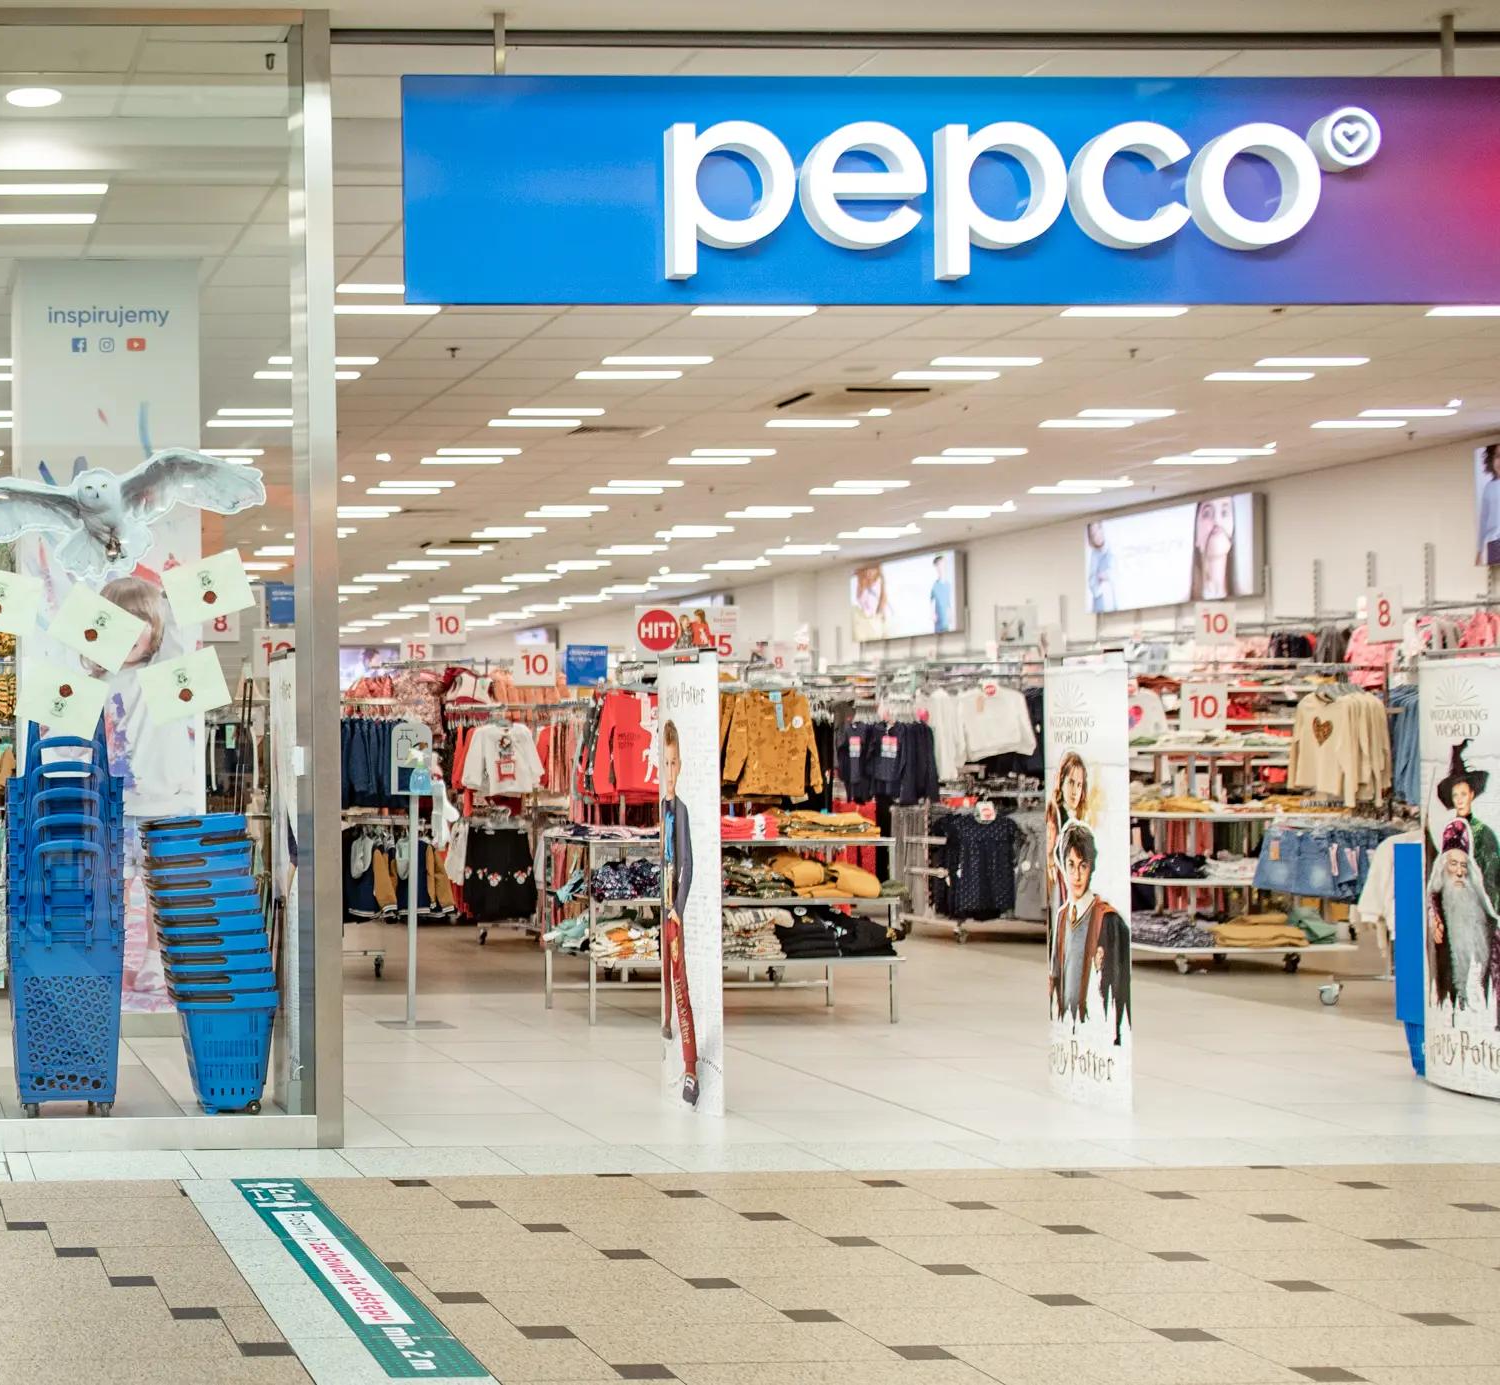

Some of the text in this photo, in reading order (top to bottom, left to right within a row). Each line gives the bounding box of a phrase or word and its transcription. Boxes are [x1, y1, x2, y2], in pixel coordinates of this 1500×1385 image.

[664, 120, 1322, 281] pepco
[48, 306, 170, 328] inspirujemy
[1203, 613, 1229, 634] 10
[1378, 599, 1391, 627] 8
[436, 616, 460, 634] 10
[640, 621, 676, 639] HIT!
[407, 644, 426, 660] 15
[707, 634, 733, 657] 15
[521, 654, 548, 675] 10
[1189, 695, 1219, 718] 10
[1430, 708, 1488, 722] WIZARDING
[1054, 730, 1089, 745] WORLD
[1436, 722, 1481, 738] WORLD
[1048, 1040, 1114, 1083] arry Potter
[1460, 1030, 1500, 1075] Pott
[308, 1242, 367, 1285] zachowanie
[347, 1286, 395, 1321] odstępu
